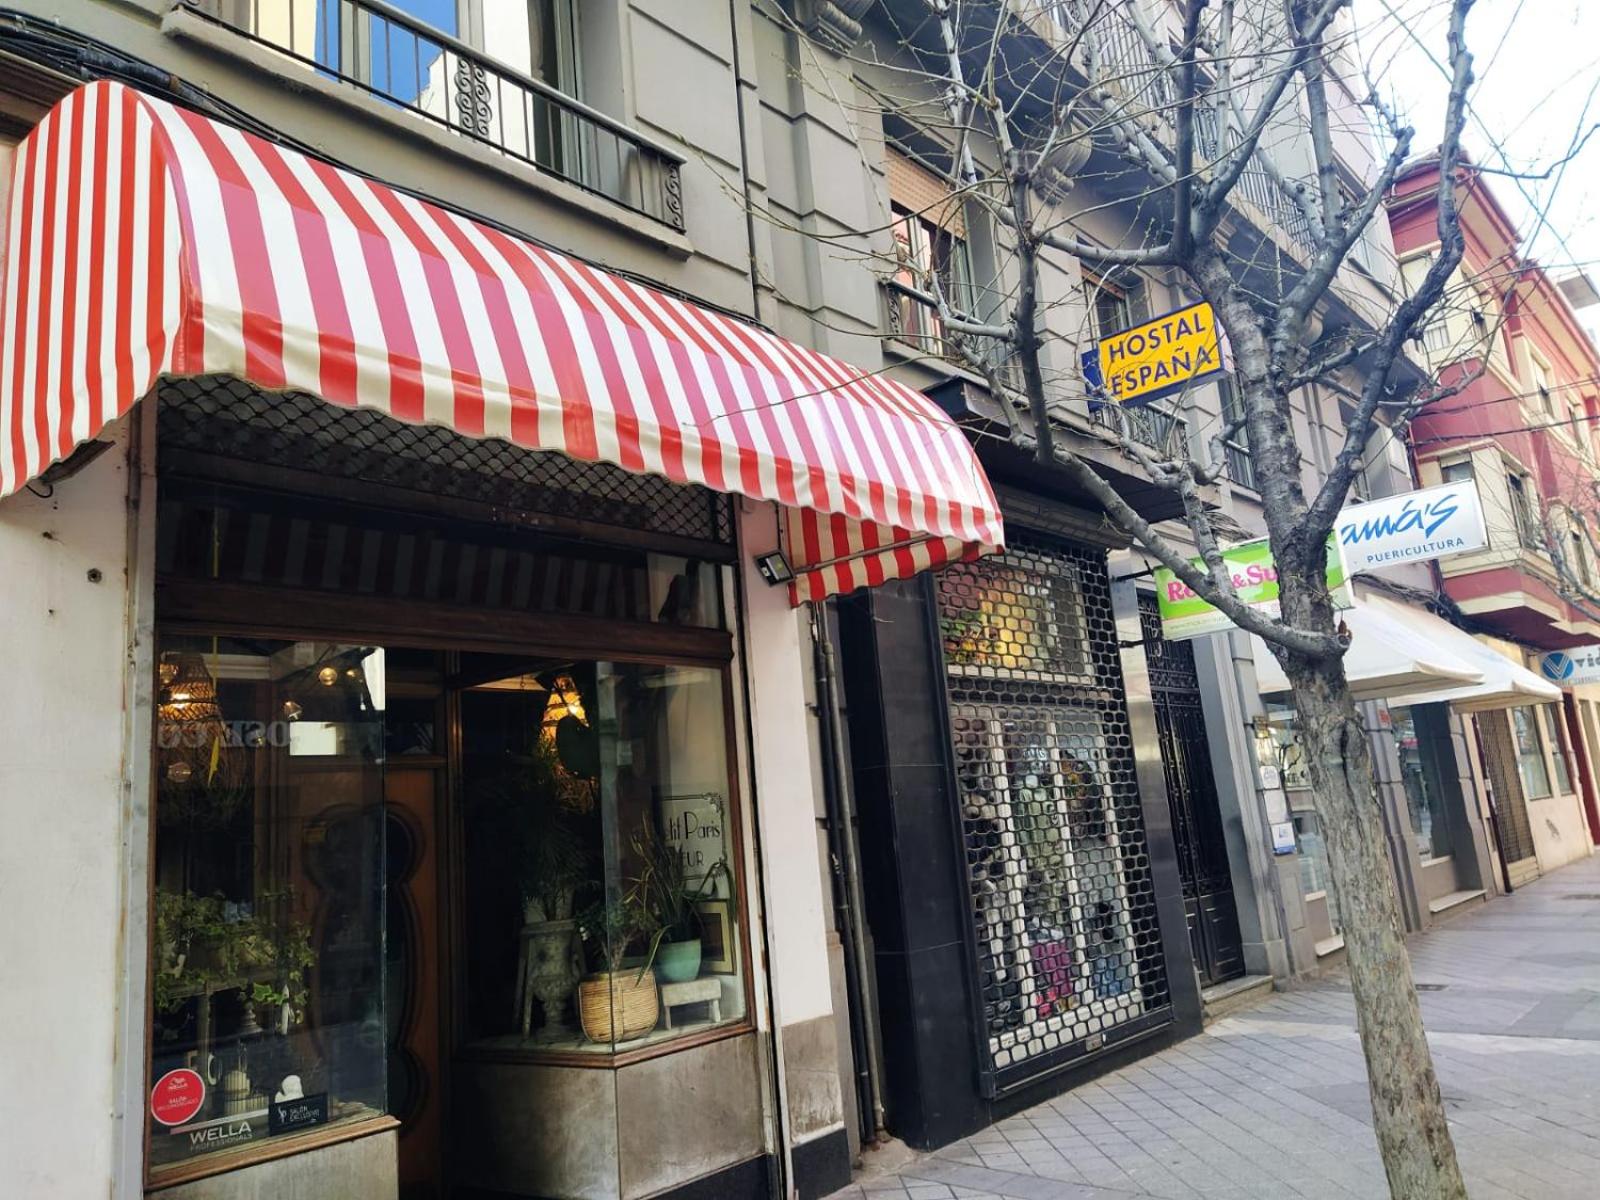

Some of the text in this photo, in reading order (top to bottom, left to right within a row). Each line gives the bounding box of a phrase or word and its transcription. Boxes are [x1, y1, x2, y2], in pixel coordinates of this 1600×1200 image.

[1109, 313, 1206, 363] HOSTAL
[1111, 345, 1213, 396] ESPAÑA
[1367, 537, 1464, 563] PUERICULTURA
[684, 811, 720, 839] Paris
[190, 1121, 252, 1145] WELLA
